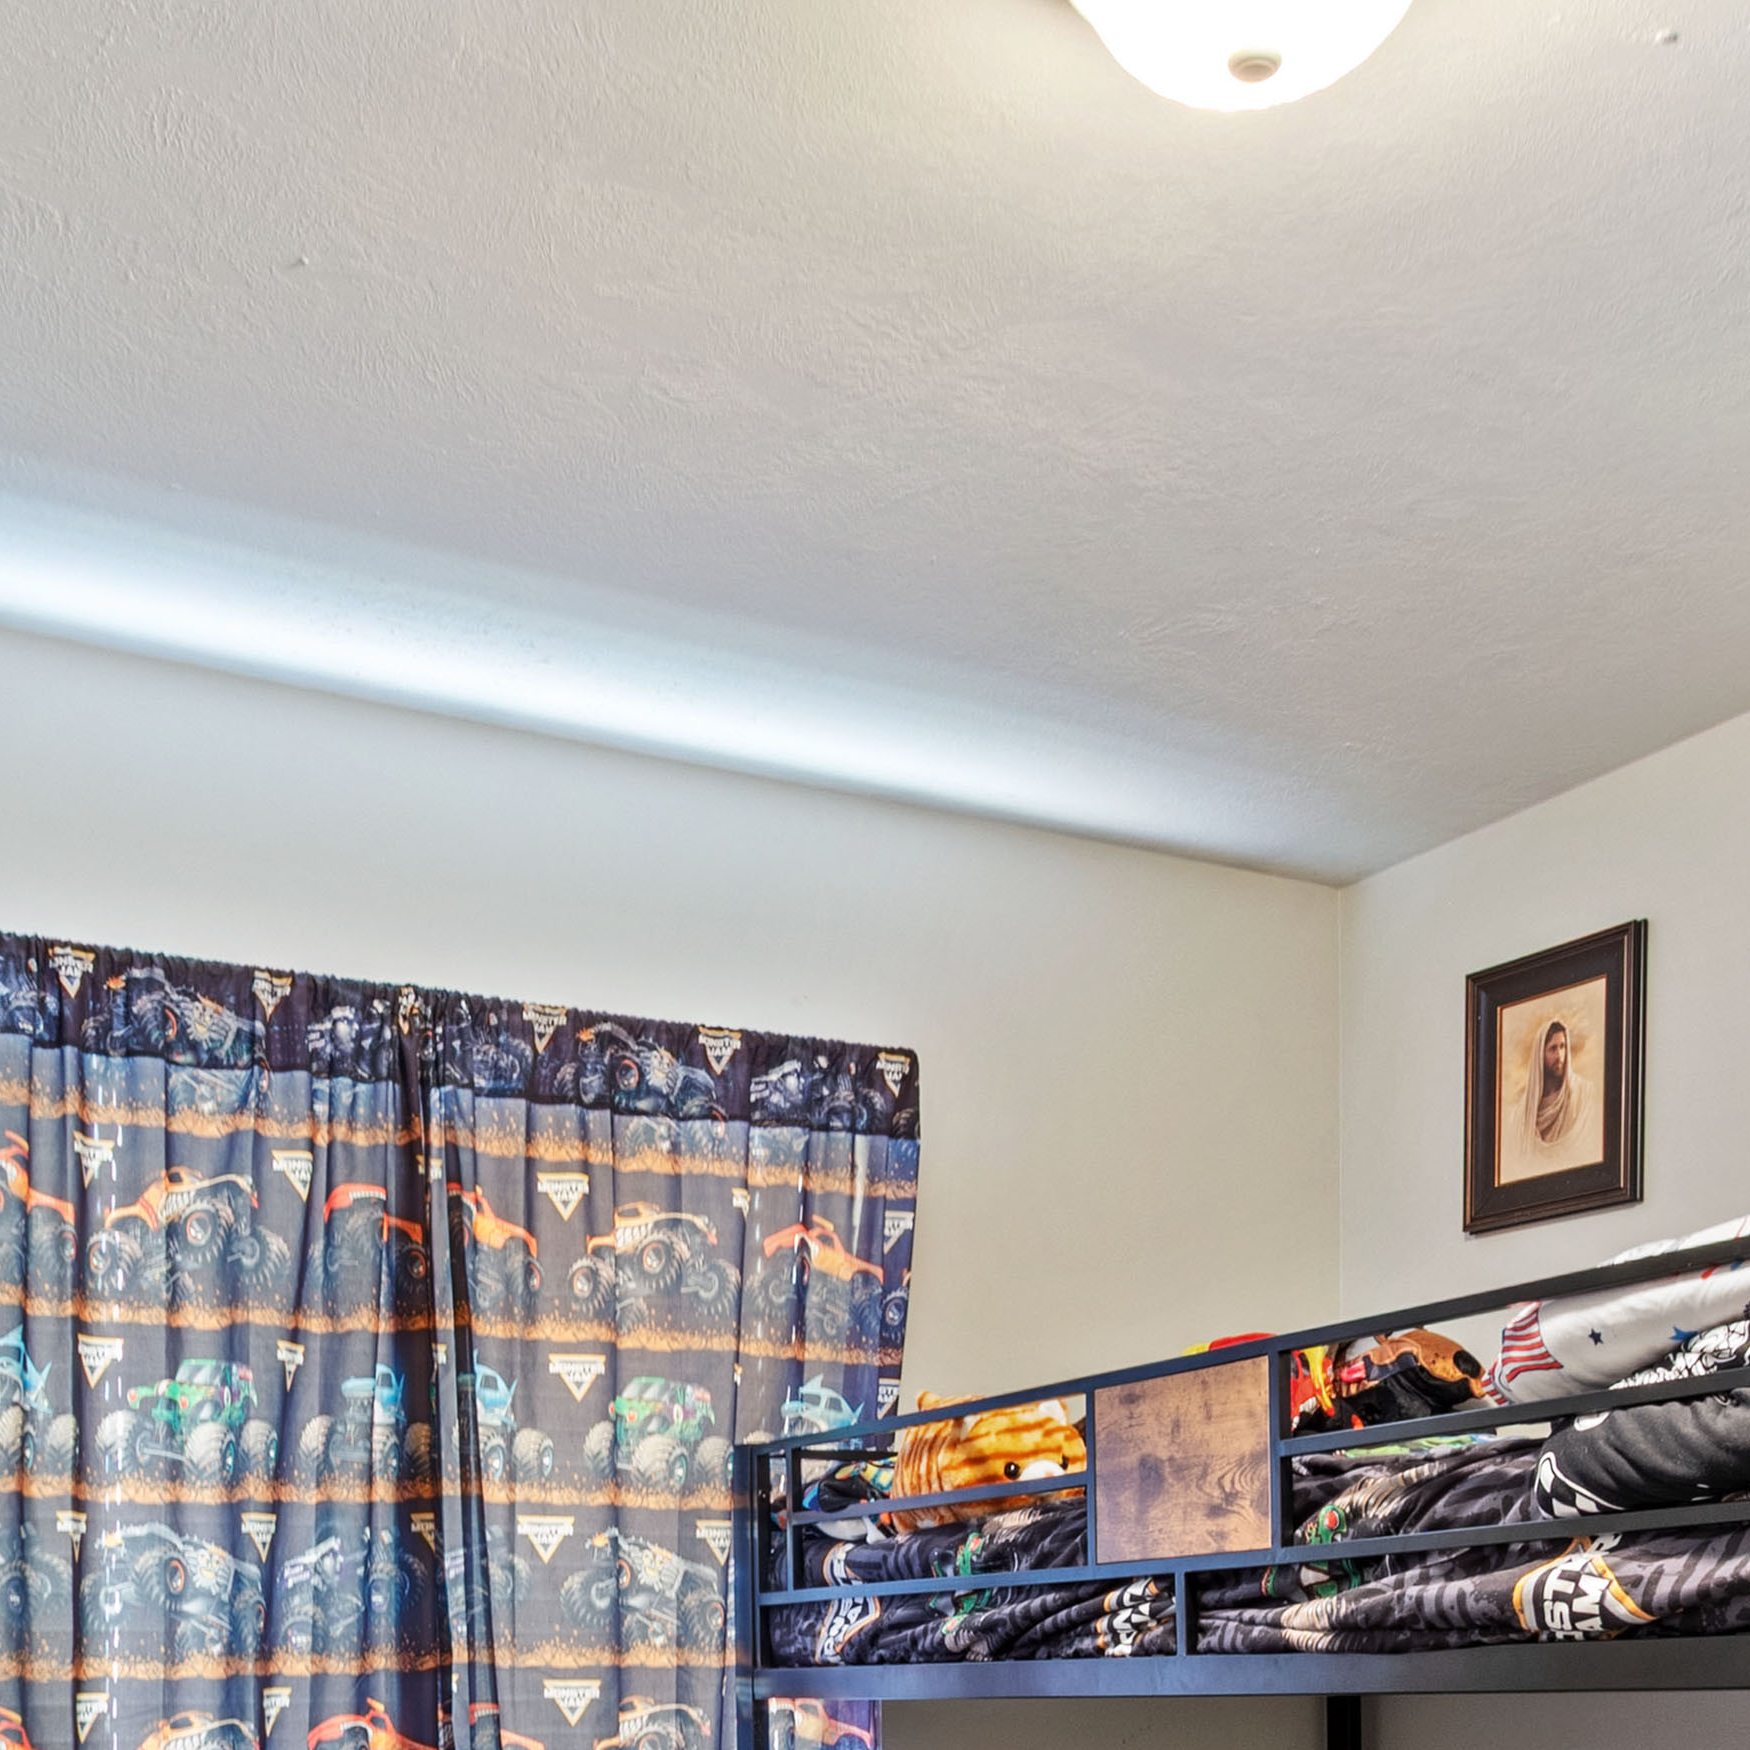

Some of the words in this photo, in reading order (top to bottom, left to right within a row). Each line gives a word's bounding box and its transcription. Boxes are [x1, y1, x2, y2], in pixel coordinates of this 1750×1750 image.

[537, 1178, 589, 1195] MONSTER
[549, 1362, 606, 1377] MONSTER
[517, 1522, 574, 1538] MONSTER
[544, 1686, 600, 1700] MONSTER
